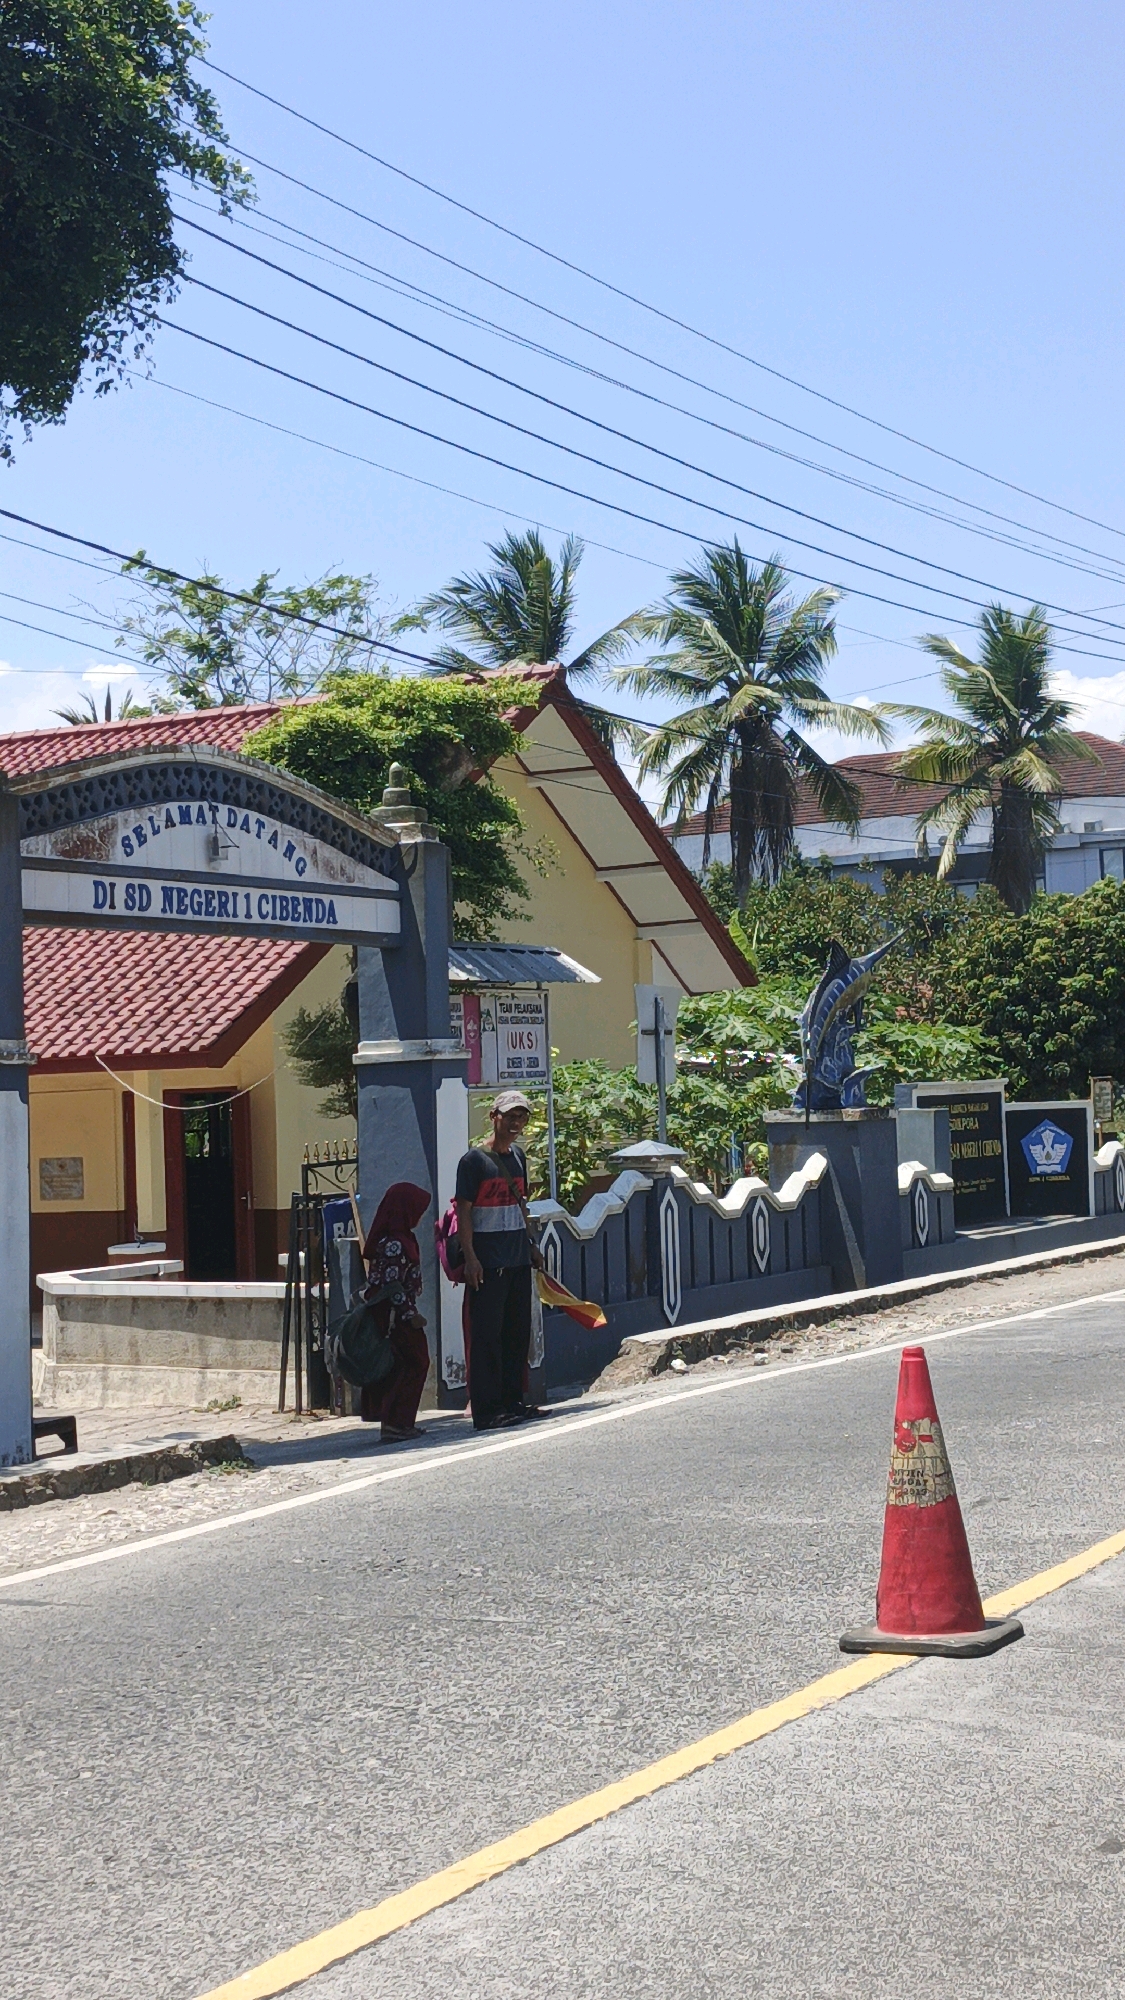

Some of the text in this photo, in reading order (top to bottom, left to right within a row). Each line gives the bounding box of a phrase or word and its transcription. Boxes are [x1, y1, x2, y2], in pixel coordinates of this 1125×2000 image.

[121, 804, 307, 877] SELAMAT DATANG
[93, 880, 338, 925] DI SD NEGERI 1 CIBENDA
